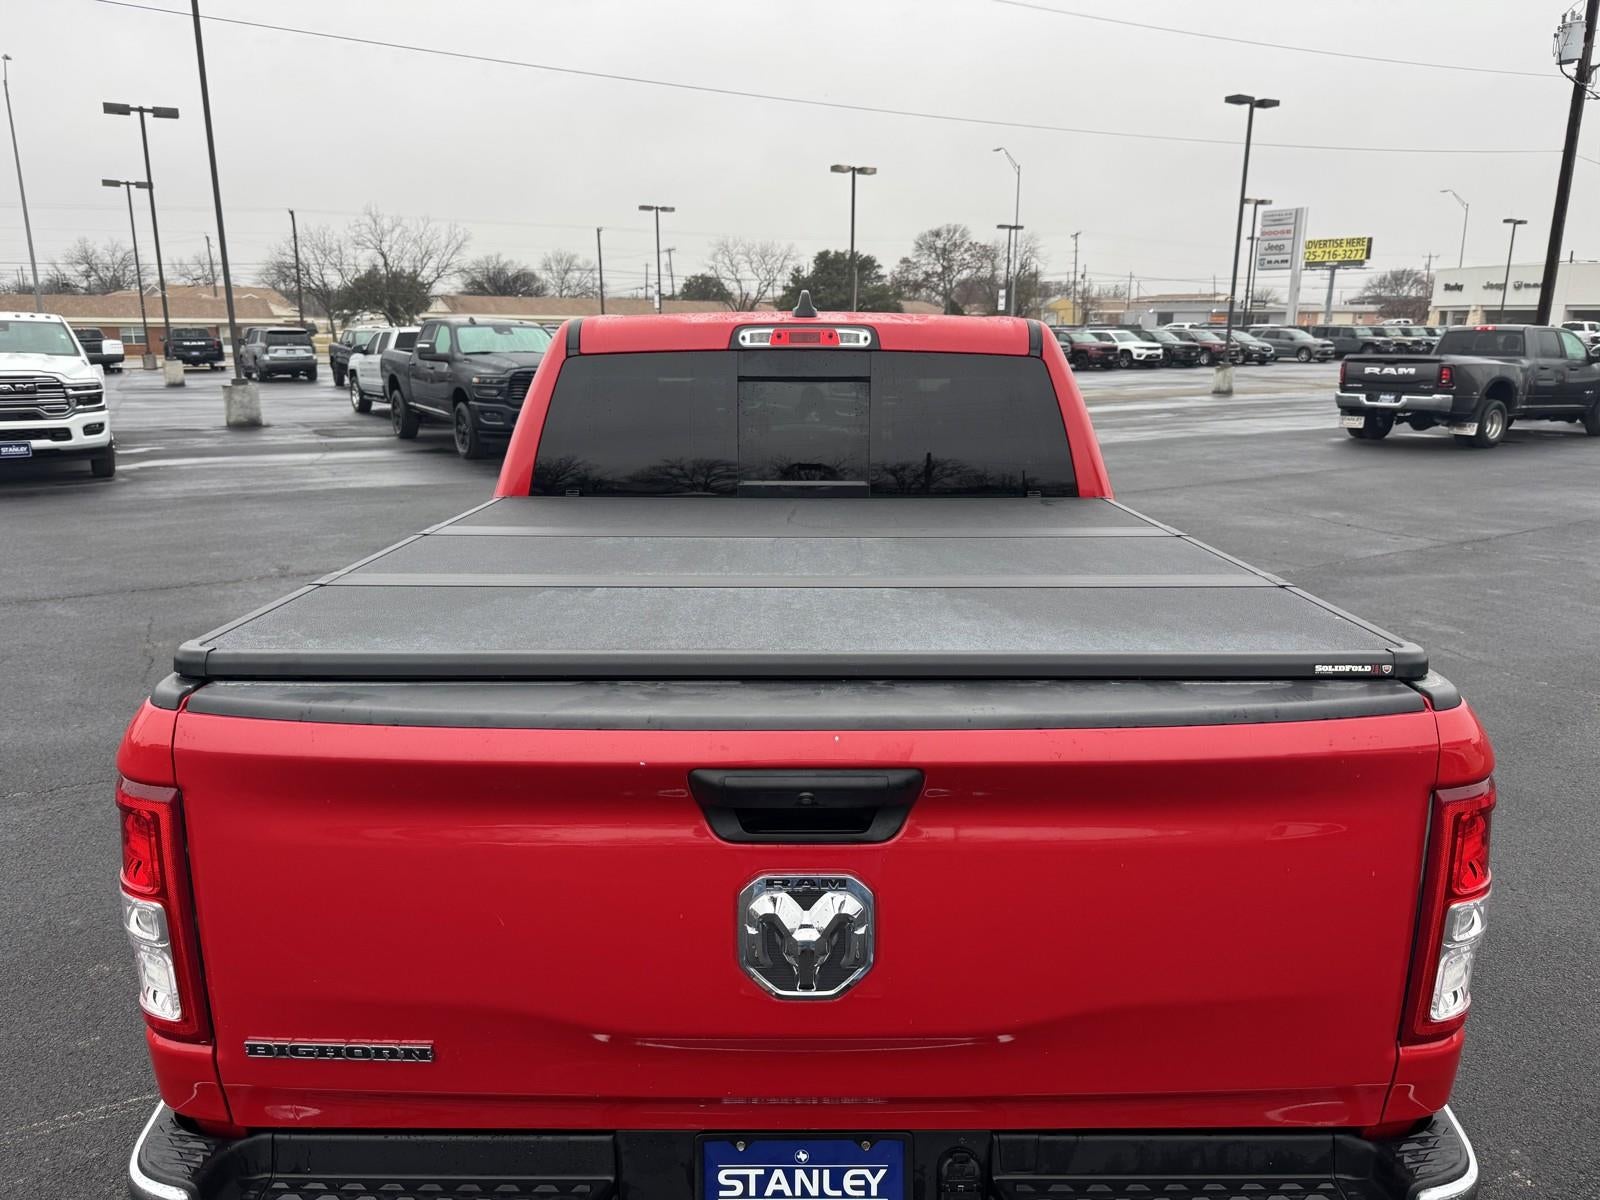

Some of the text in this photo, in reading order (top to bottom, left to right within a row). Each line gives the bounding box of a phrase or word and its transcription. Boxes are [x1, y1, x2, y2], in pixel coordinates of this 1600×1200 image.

[1264, 242, 1285, 252] Jeep
[1346, 237, 1366, 248] HERE
[1304, 249, 1365, 260] 25-716-3277
[1364, 367, 1416, 375] RAM
[0, 384, 36, 392] AM
[766, 879, 847, 890] RAM
[244, 1040, 434, 1062] BIGHORN
[717, 1168, 888, 1197] STANLEY
